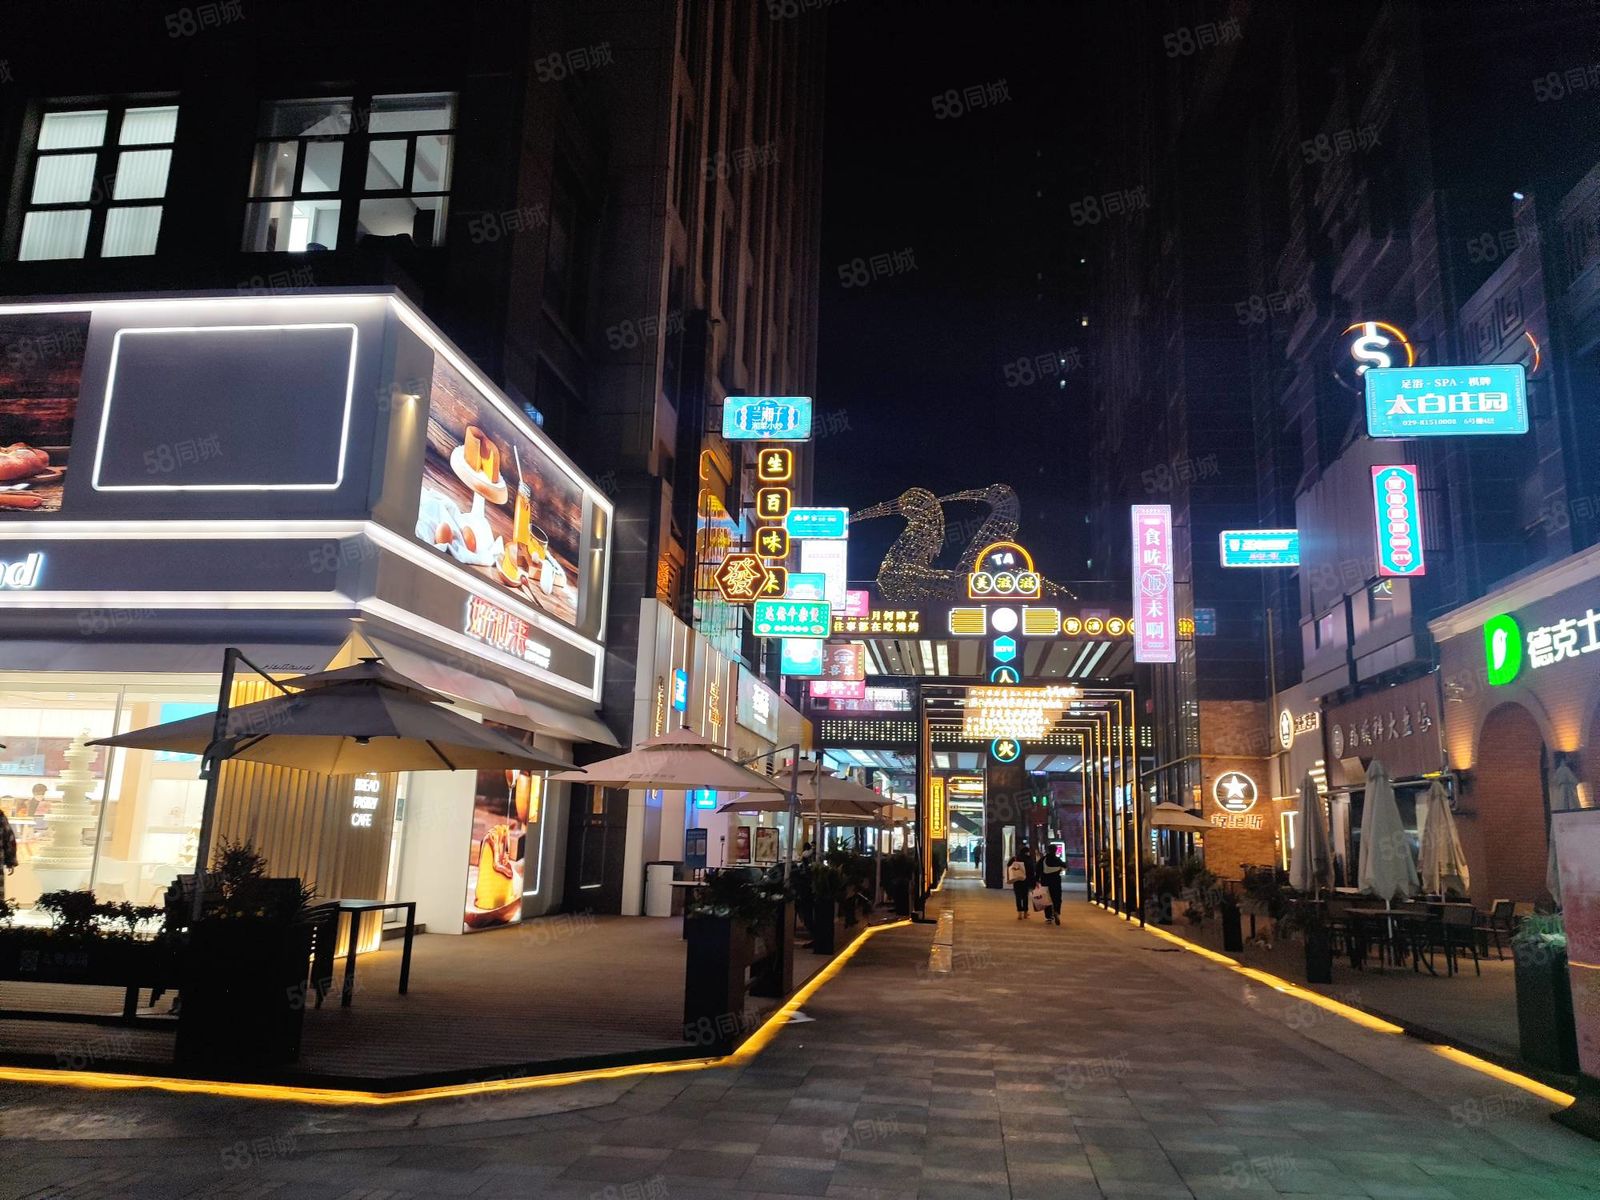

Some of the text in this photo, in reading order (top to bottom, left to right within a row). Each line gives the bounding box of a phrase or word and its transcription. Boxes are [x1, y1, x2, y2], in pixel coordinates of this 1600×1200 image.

[1434, 378, 1457, 388] SPA
[1384, 392, 1509, 415] 太白庄园
[991, 553, 1015, 566] TA
[721, 557, 761, 595] 發
[976, 576, 1036, 590] 美滋滋
[465, 595, 530, 656] 好利来
[1527, 608, 1600, 669] 德克士
[999, 669, 1013, 683] 人
[998, 742, 1015, 757] 火
[351, 813, 373, 828] CAFE
